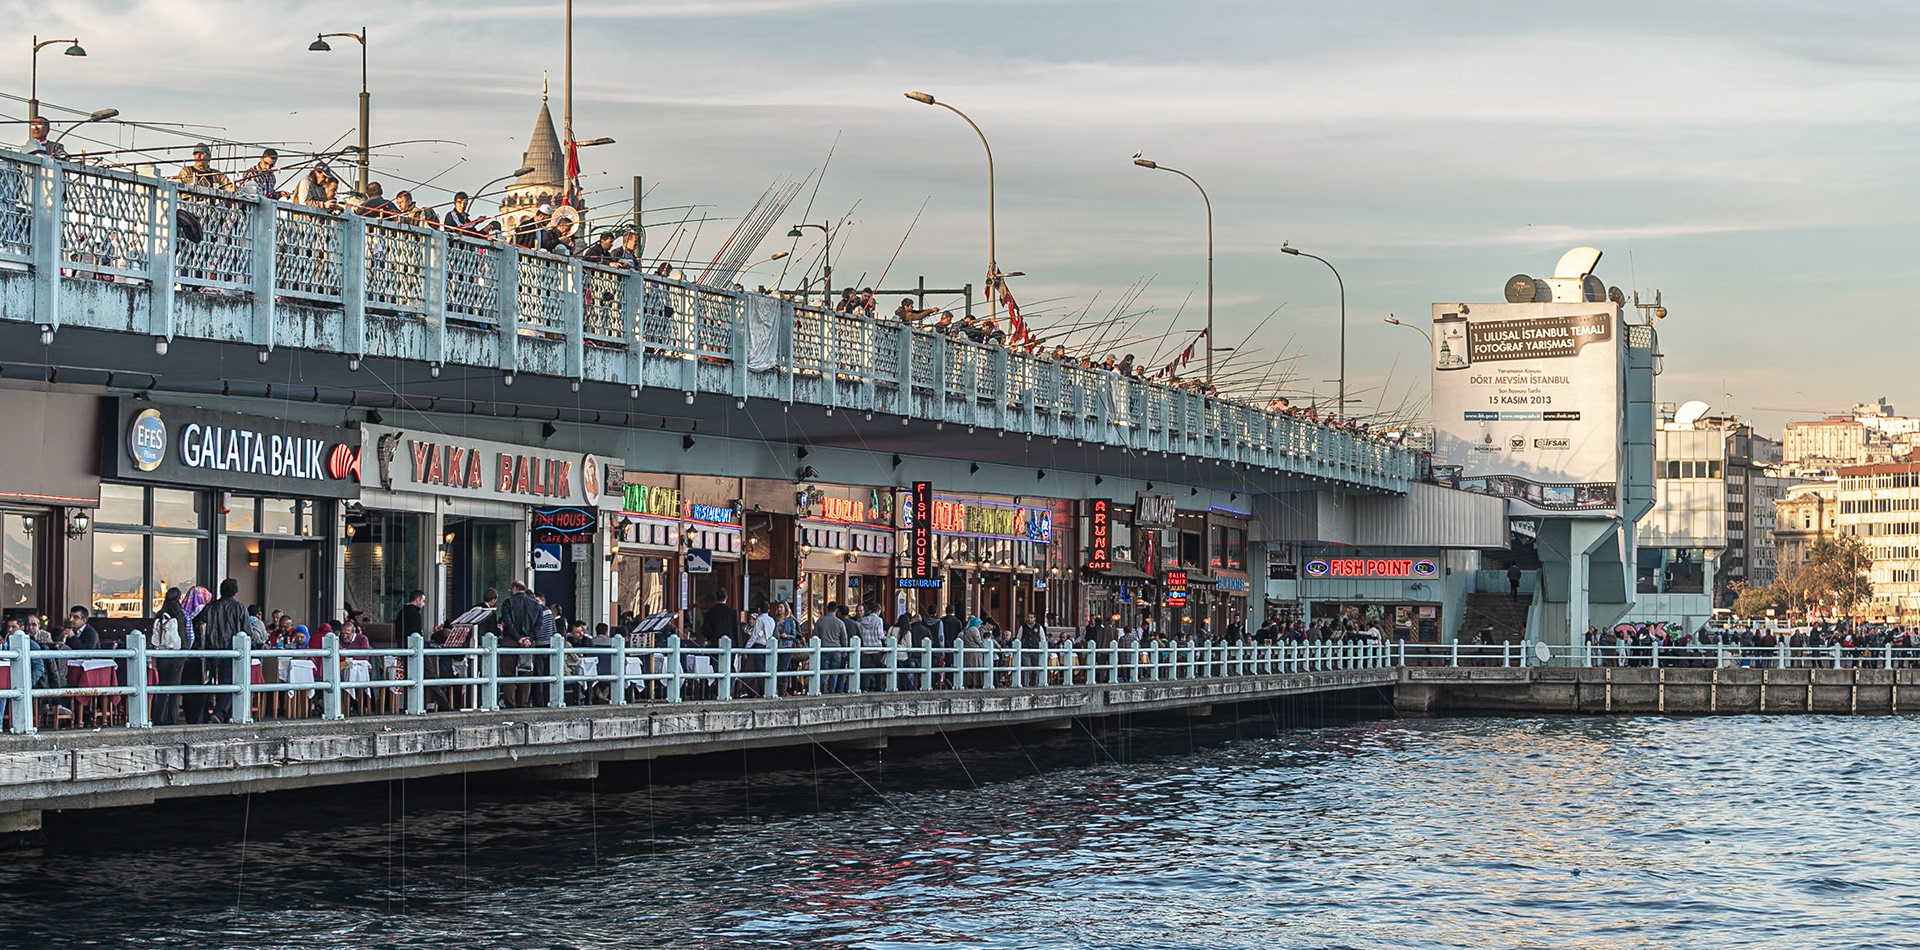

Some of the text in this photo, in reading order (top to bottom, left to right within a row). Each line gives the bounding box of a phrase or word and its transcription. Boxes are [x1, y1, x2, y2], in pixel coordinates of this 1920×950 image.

[1474, 325, 1605, 343] 1. ULUSAL İSTANBUL TEMALI
[1474, 339, 1575, 353] FOTOĞRAF YARIŞMASI
[1470, 374, 1570, 385] DÖRT MEVSİM İSTANBUL
[1489, 396, 1552, 404] 15 KASIM 2013
[137, 425, 163, 450] EFES
[183, 422, 325, 481] GALATA BALIK
[411, 439, 482, 489] YAKA
[499, 452, 573, 498] BALIK
[650, 485, 681, 517] CAFE
[534, 513, 587, 527] FISH HOUSE
[916, 483, 927, 576] FISH HOUSE
[1094, 500, 1107, 560] ARUNA
[540, 535, 588, 543] CAFE & BAR
[1330, 559, 1364, 577] FISH
[1366, 559, 1413, 577] POINT
[899, 579, 941, 588] RESTAURANT
